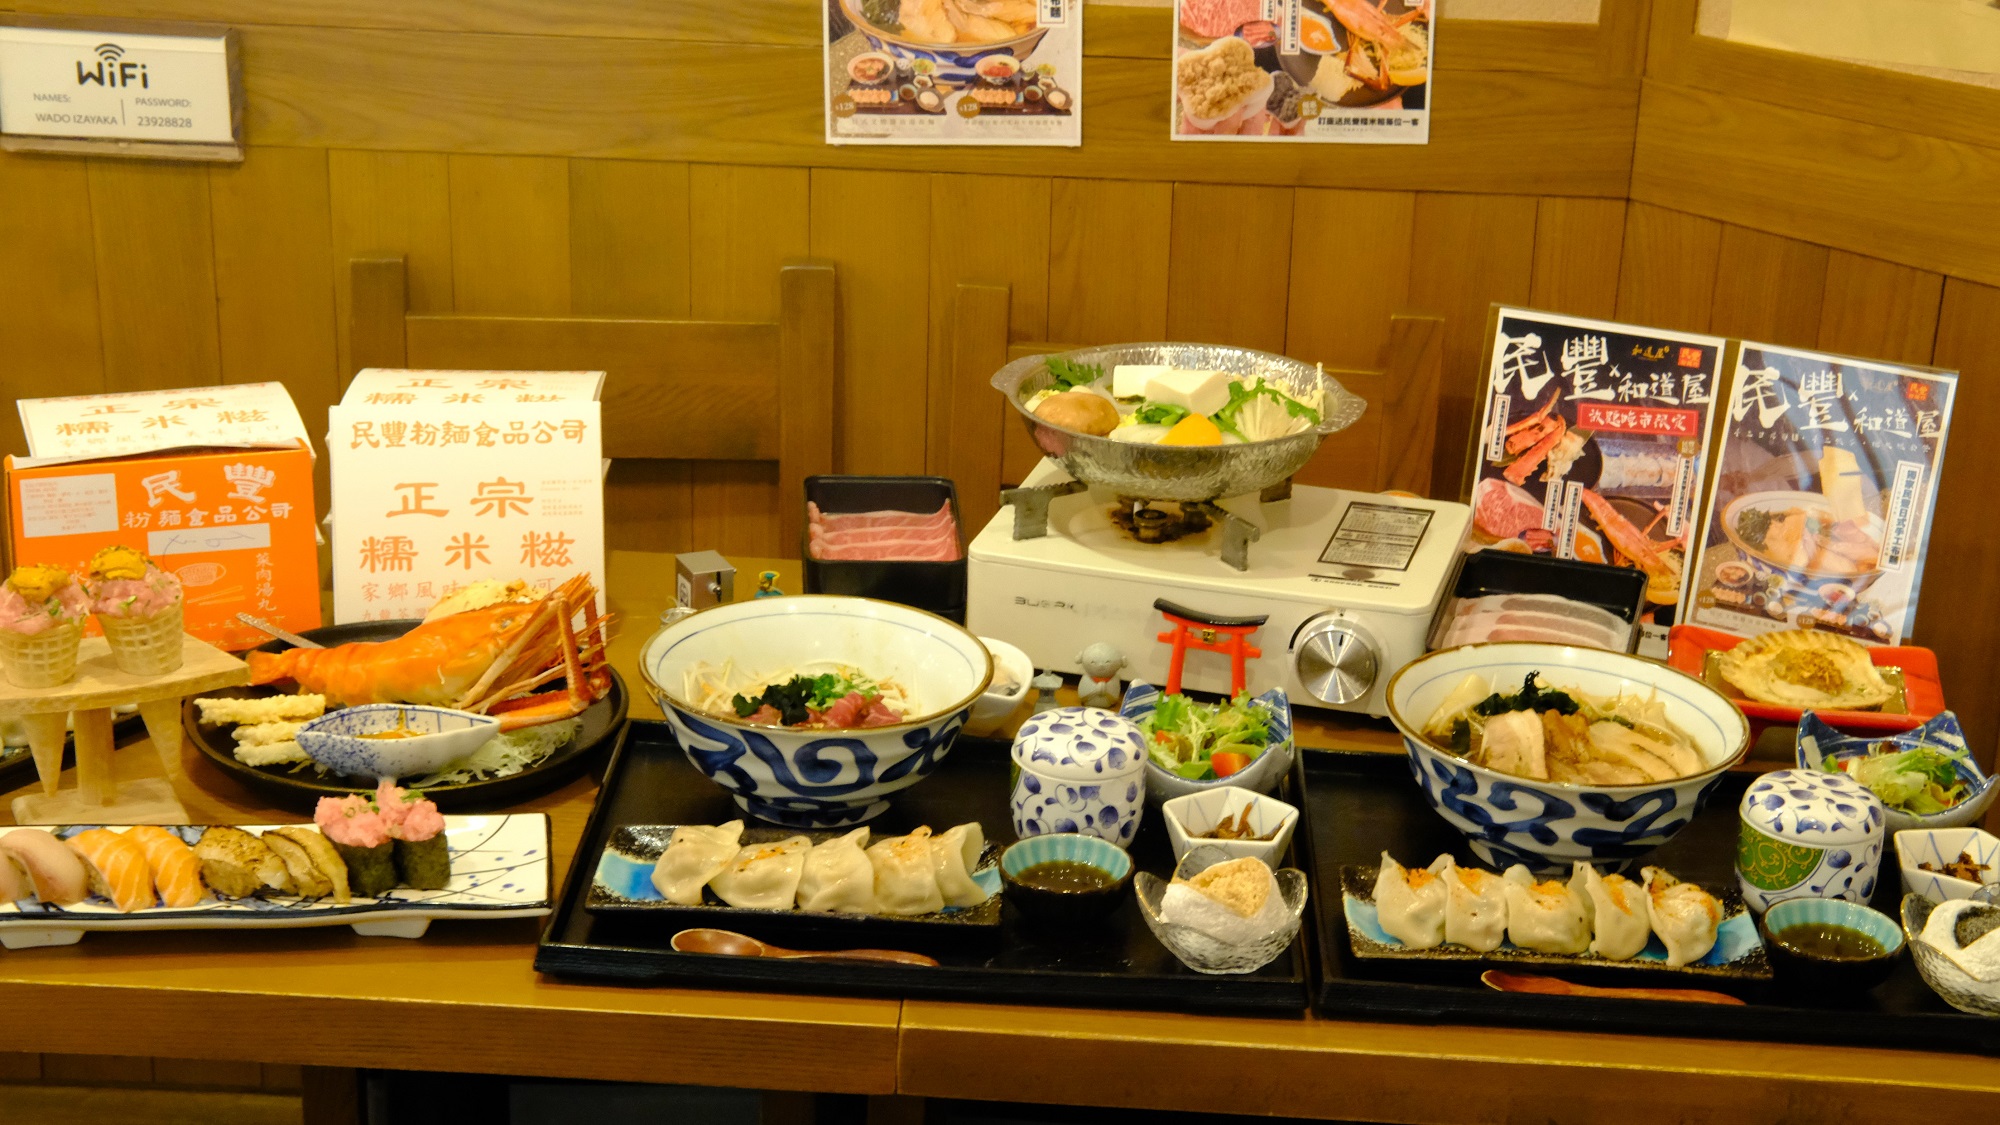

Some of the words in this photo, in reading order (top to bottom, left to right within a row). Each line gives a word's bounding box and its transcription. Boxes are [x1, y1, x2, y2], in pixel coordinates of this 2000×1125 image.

[76, 61, 149, 89] WiFi
[33, 93, 71, 102] NAMES:
[135, 97, 192, 108] PASSWORD:
[36, 113, 71, 123] WADO
[73, 114, 118, 125] IZAYAKA
[137, 115, 192, 128] 23928828
[1493, 332, 1616, 401] 民豐
[1617, 371, 1711, 405] 和道屋
[1732, 364, 1849, 432] 民豐
[1853, 406, 1942, 438] 和道屋
[350, 418, 588, 449] 民豐粉麵食品公司
[142, 462, 276, 508] 民豐
[385, 476, 534, 518] 正宗
[124, 502, 293, 529] 粉麵食品公司
[359, 530, 576, 574] 糯米糍
